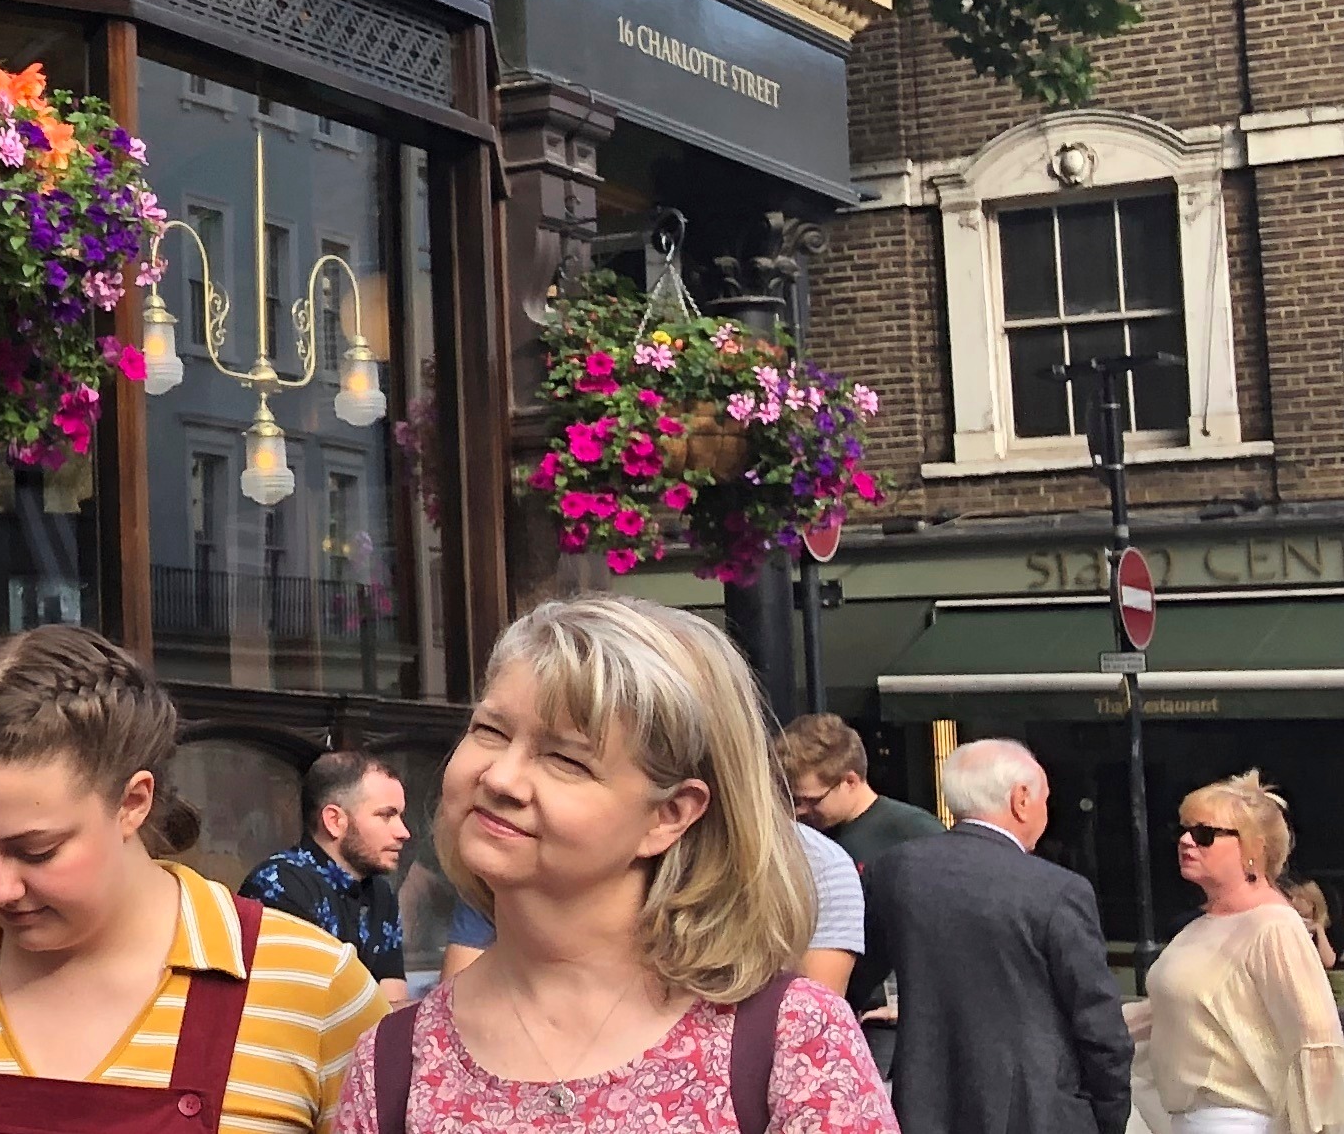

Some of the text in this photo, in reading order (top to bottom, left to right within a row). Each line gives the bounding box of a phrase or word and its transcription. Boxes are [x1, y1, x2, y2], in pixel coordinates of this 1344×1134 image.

[617, 16, 781, 108] 16 CHARLOTTE STREET
[1140, 696, 1219, 715] estaurant
